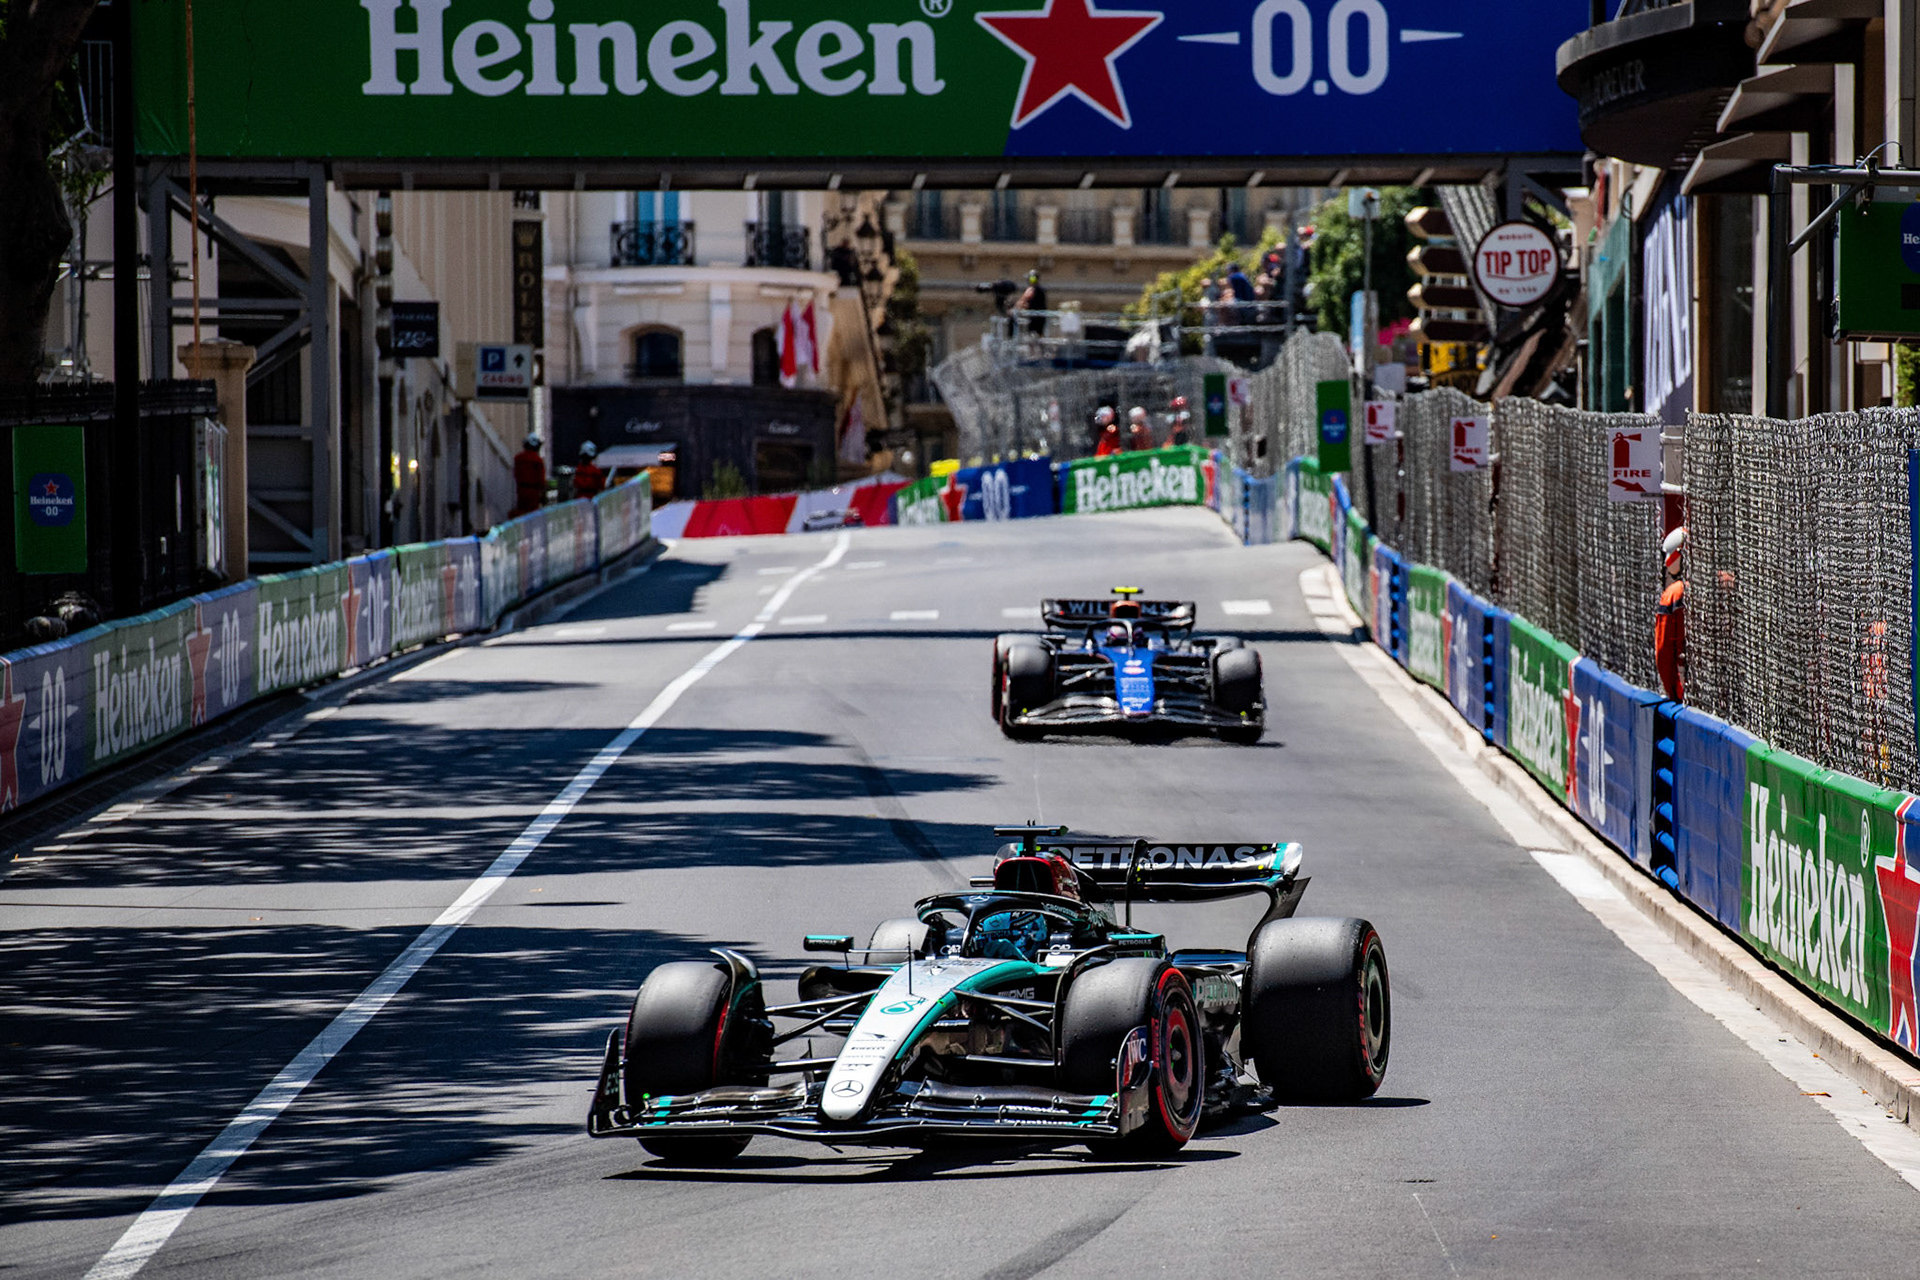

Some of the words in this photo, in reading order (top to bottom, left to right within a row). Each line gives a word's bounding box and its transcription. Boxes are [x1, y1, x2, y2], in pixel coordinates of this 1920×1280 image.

[1251, 0, 1389, 96] 0.0
[1483, 251, 1512, 275] TIP
[1516, 249, 1552, 275] TOP
[486, 352, 499, 367] P
[1075, 458, 1198, 513] Heineken
[1613, 469, 1651, 478] FIRE
[30, 496, 73, 505] Heineken
[1068, 601, 1170, 616] WILMS
[258, 593, 338, 693] Heineken
[93, 637, 183, 760] Heineken
[41, 666, 66, 785] 0.0
[1750, 781, 1870, 1009] Heineken
[1126, 1038, 1147, 1064] IWC
